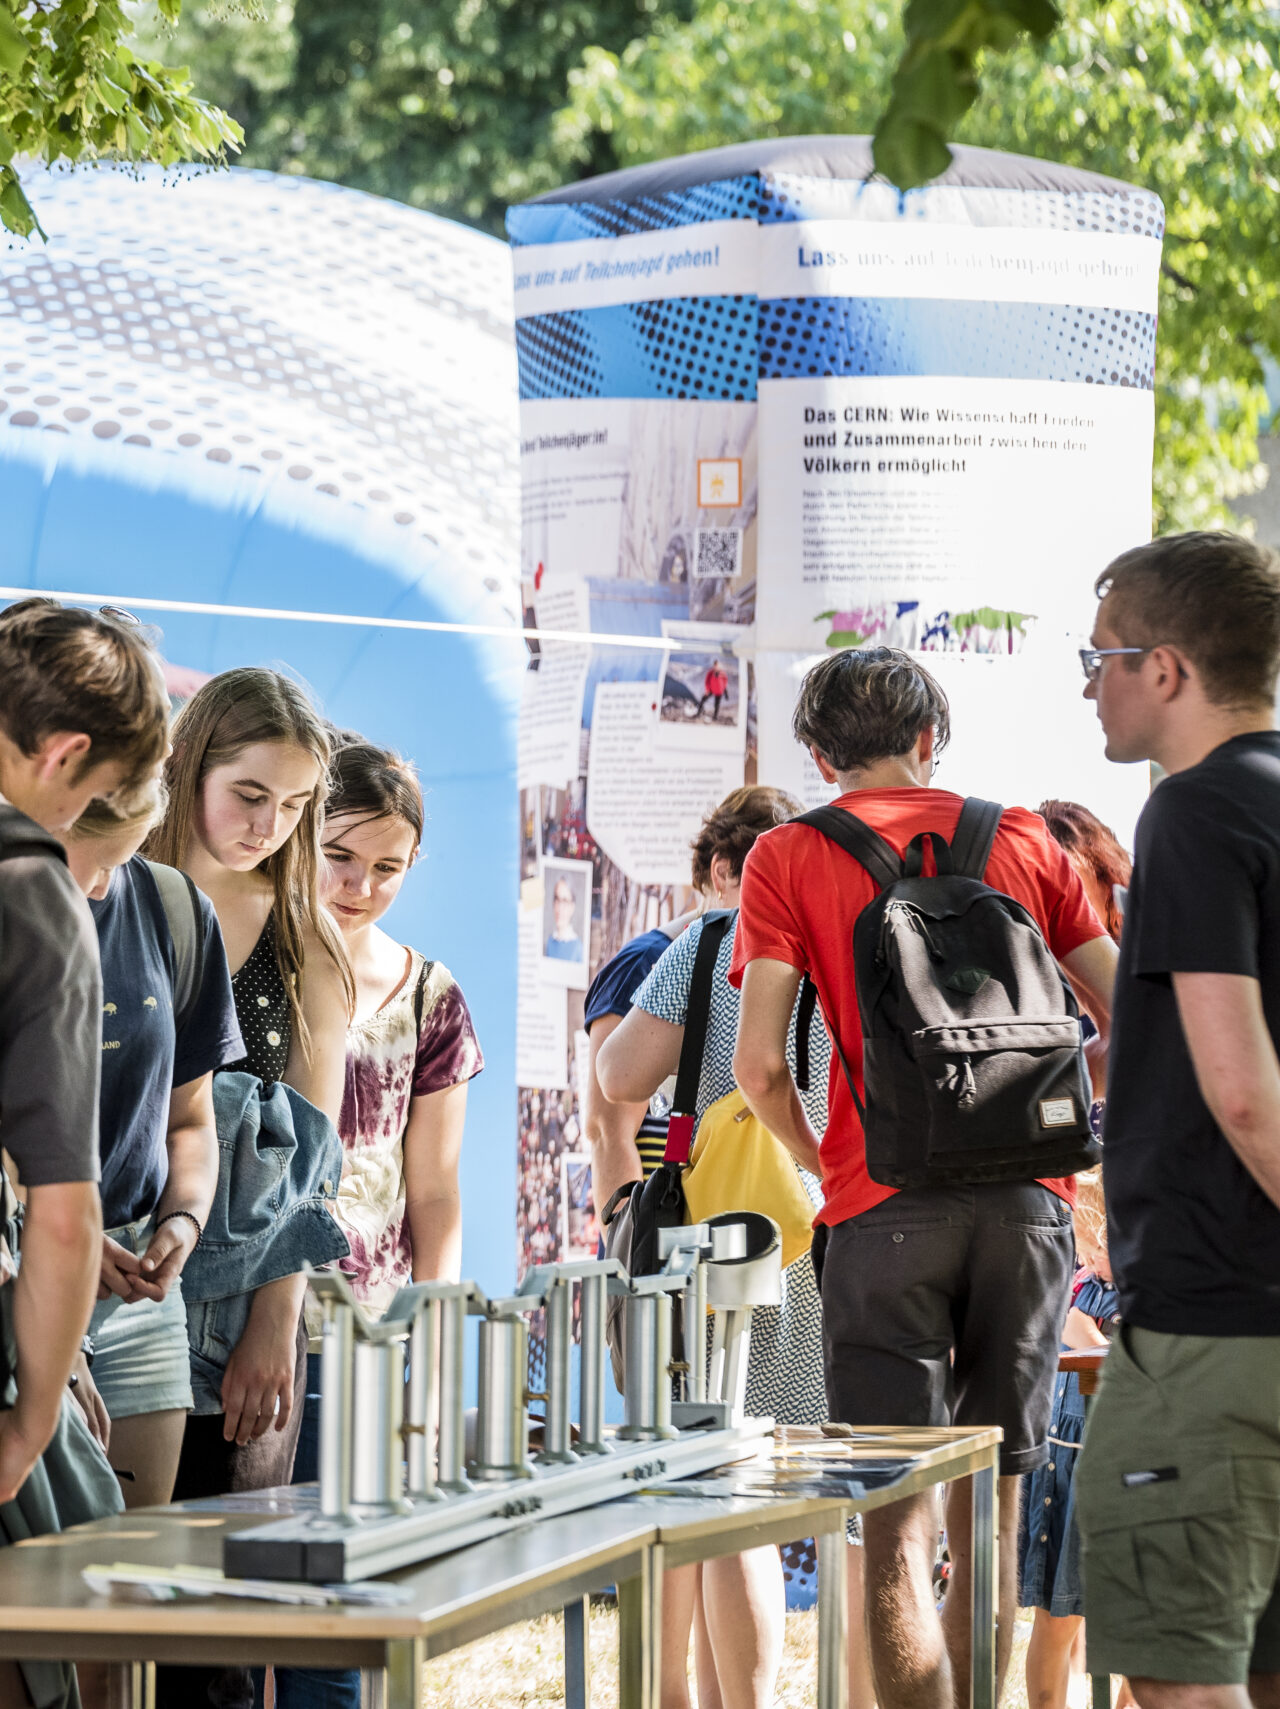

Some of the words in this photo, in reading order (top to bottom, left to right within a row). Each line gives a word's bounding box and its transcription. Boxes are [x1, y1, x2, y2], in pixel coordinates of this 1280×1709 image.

[798, 246, 848, 268] Lass
[514, 272, 531, 291] ass
[666, 244, 720, 275] gehen!
[803, 406, 836, 424] Das
[844, 406, 893, 423] CERN:
[900, 407, 929, 423] Wie
[936, 408, 1037, 425] Wissenschaft
[803, 431, 836, 448] und
[844, 431, 982, 447] Zusammenarbeit
[989, 435, 1057, 449] zwischen
[803, 456, 870, 474] Völkern
[878, 458, 966, 476] ermöglicht
